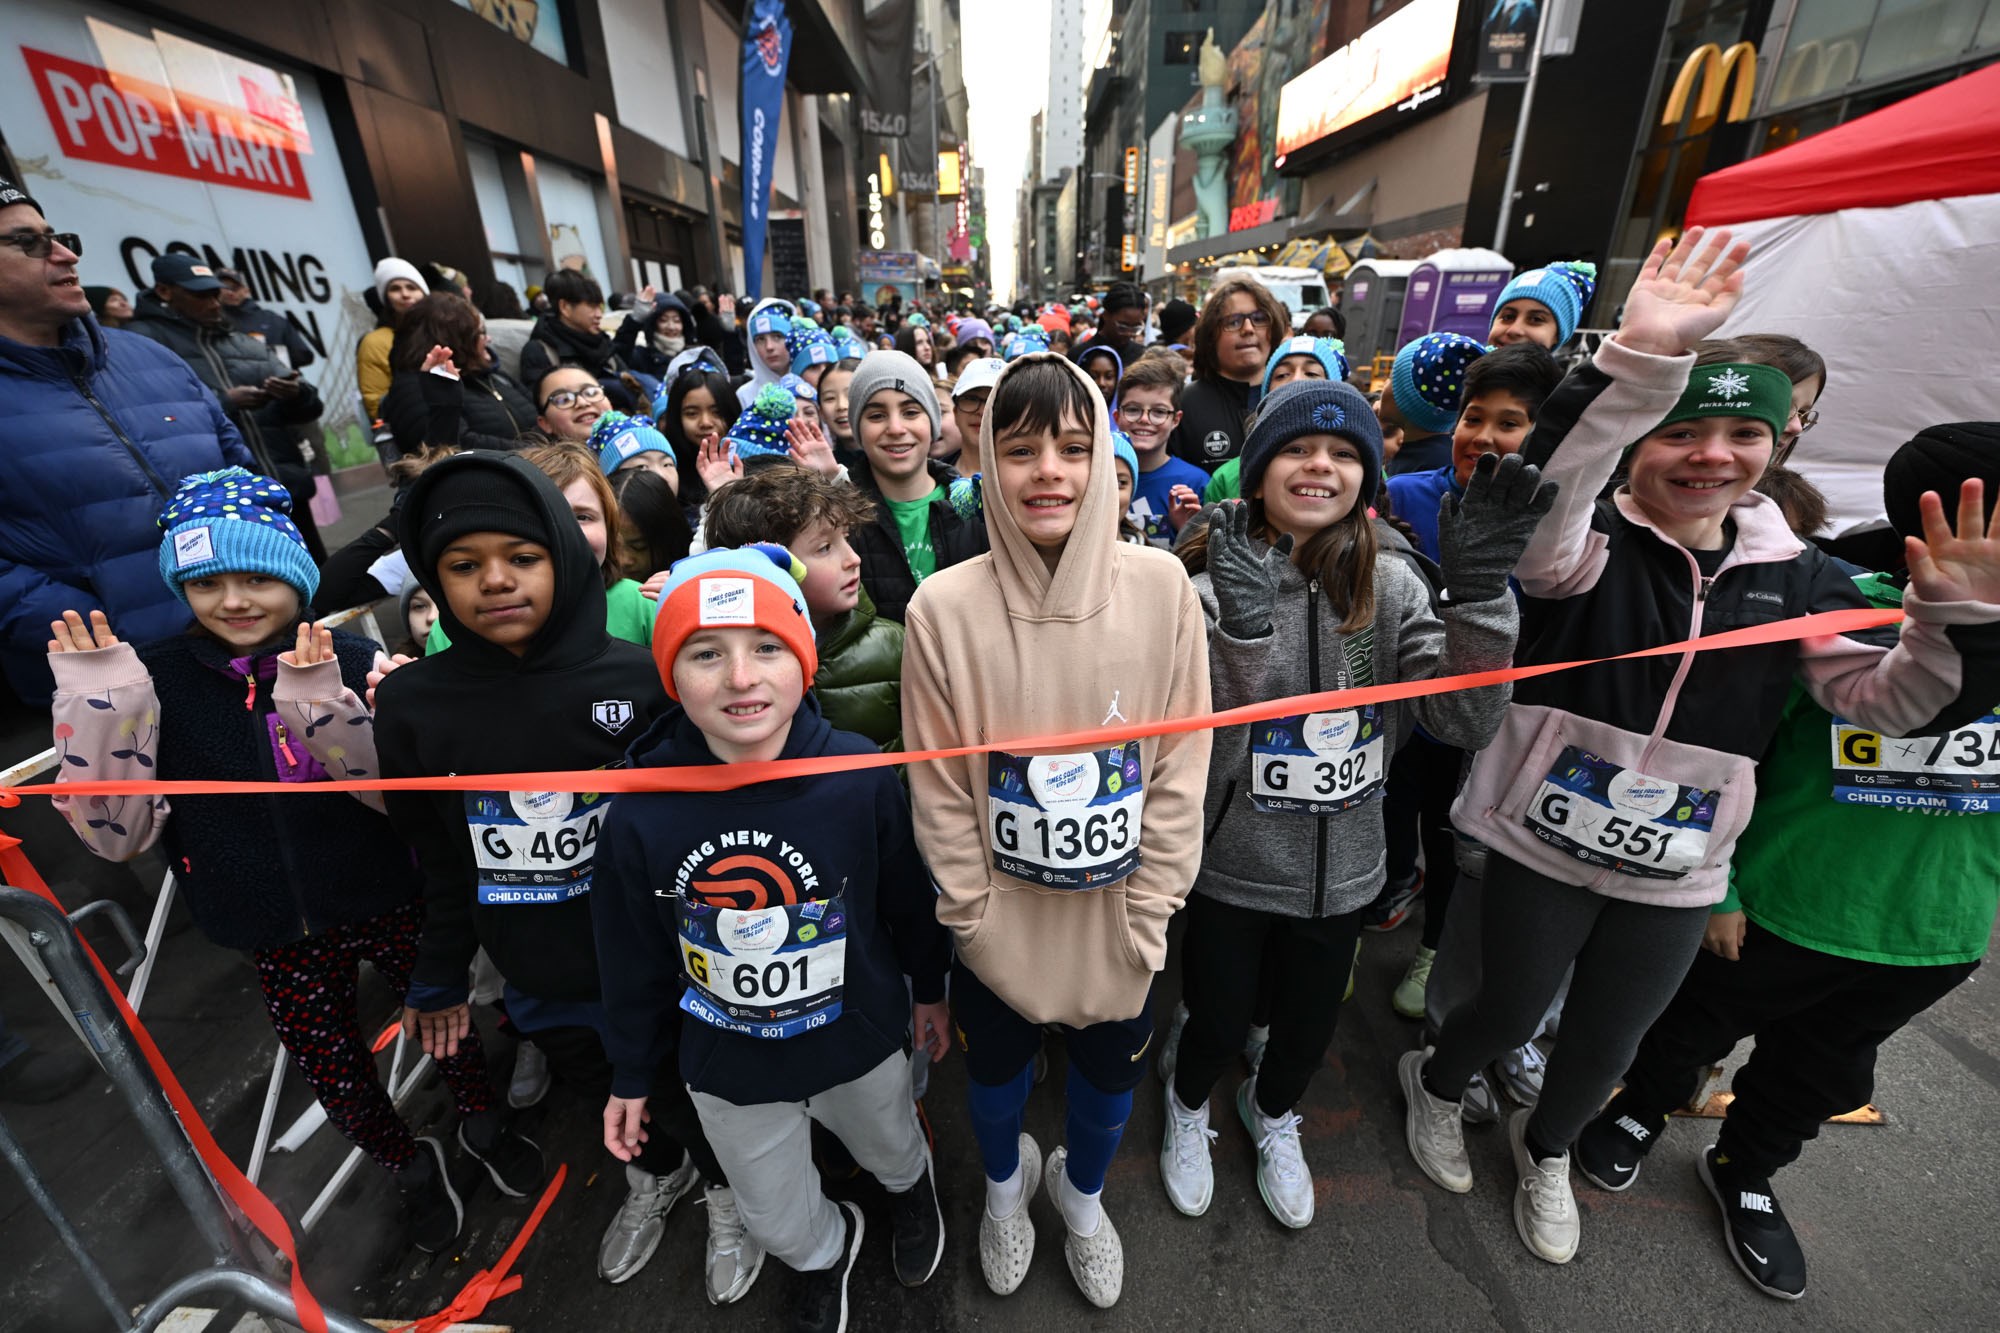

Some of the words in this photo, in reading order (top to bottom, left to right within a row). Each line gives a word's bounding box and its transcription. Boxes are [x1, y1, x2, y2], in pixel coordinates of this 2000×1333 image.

[45, 68, 162, 160] POP
[178, 108, 296, 189] MART
[860, 109, 907, 136] 1540
[867, 173, 885, 249] 1540
[1843, 733, 1877, 764] G
[1263, 760, 1289, 790] G
[1314, 751, 1366, 795] 392
[1855, 774, 1875, 784] tcs
[1847, 793, 1892, 804] CHILD
[1896, 795, 1947, 808] CLAIM
[1961, 799, 1989, 810] 734
[482, 828, 513, 860] G
[530, 815, 600, 863] 464
[995, 811, 1018, 851] G
[1034, 807, 1129, 860] 1363
[1541, 794, 1570, 825] G
[1597, 816, 1673, 863] 551
[492, 873, 508, 883] tcs
[720, 830, 773, 848] NEW
[778, 841, 819, 891] YORK
[487, 892, 521, 902] CHILD
[523, 892, 558, 901] CLAIM
[567, 882, 591, 897] 464
[688, 950, 708, 984] G
[732, 956, 809, 999] 601
[689, 1000, 715, 1023] CHILD
[715, 1017, 752, 1034] CLAIM
[761, 1027, 784, 1038] 601
[1614, 1115, 1650, 1142] NIKE
[1740, 1191, 1773, 1214] NIKE
